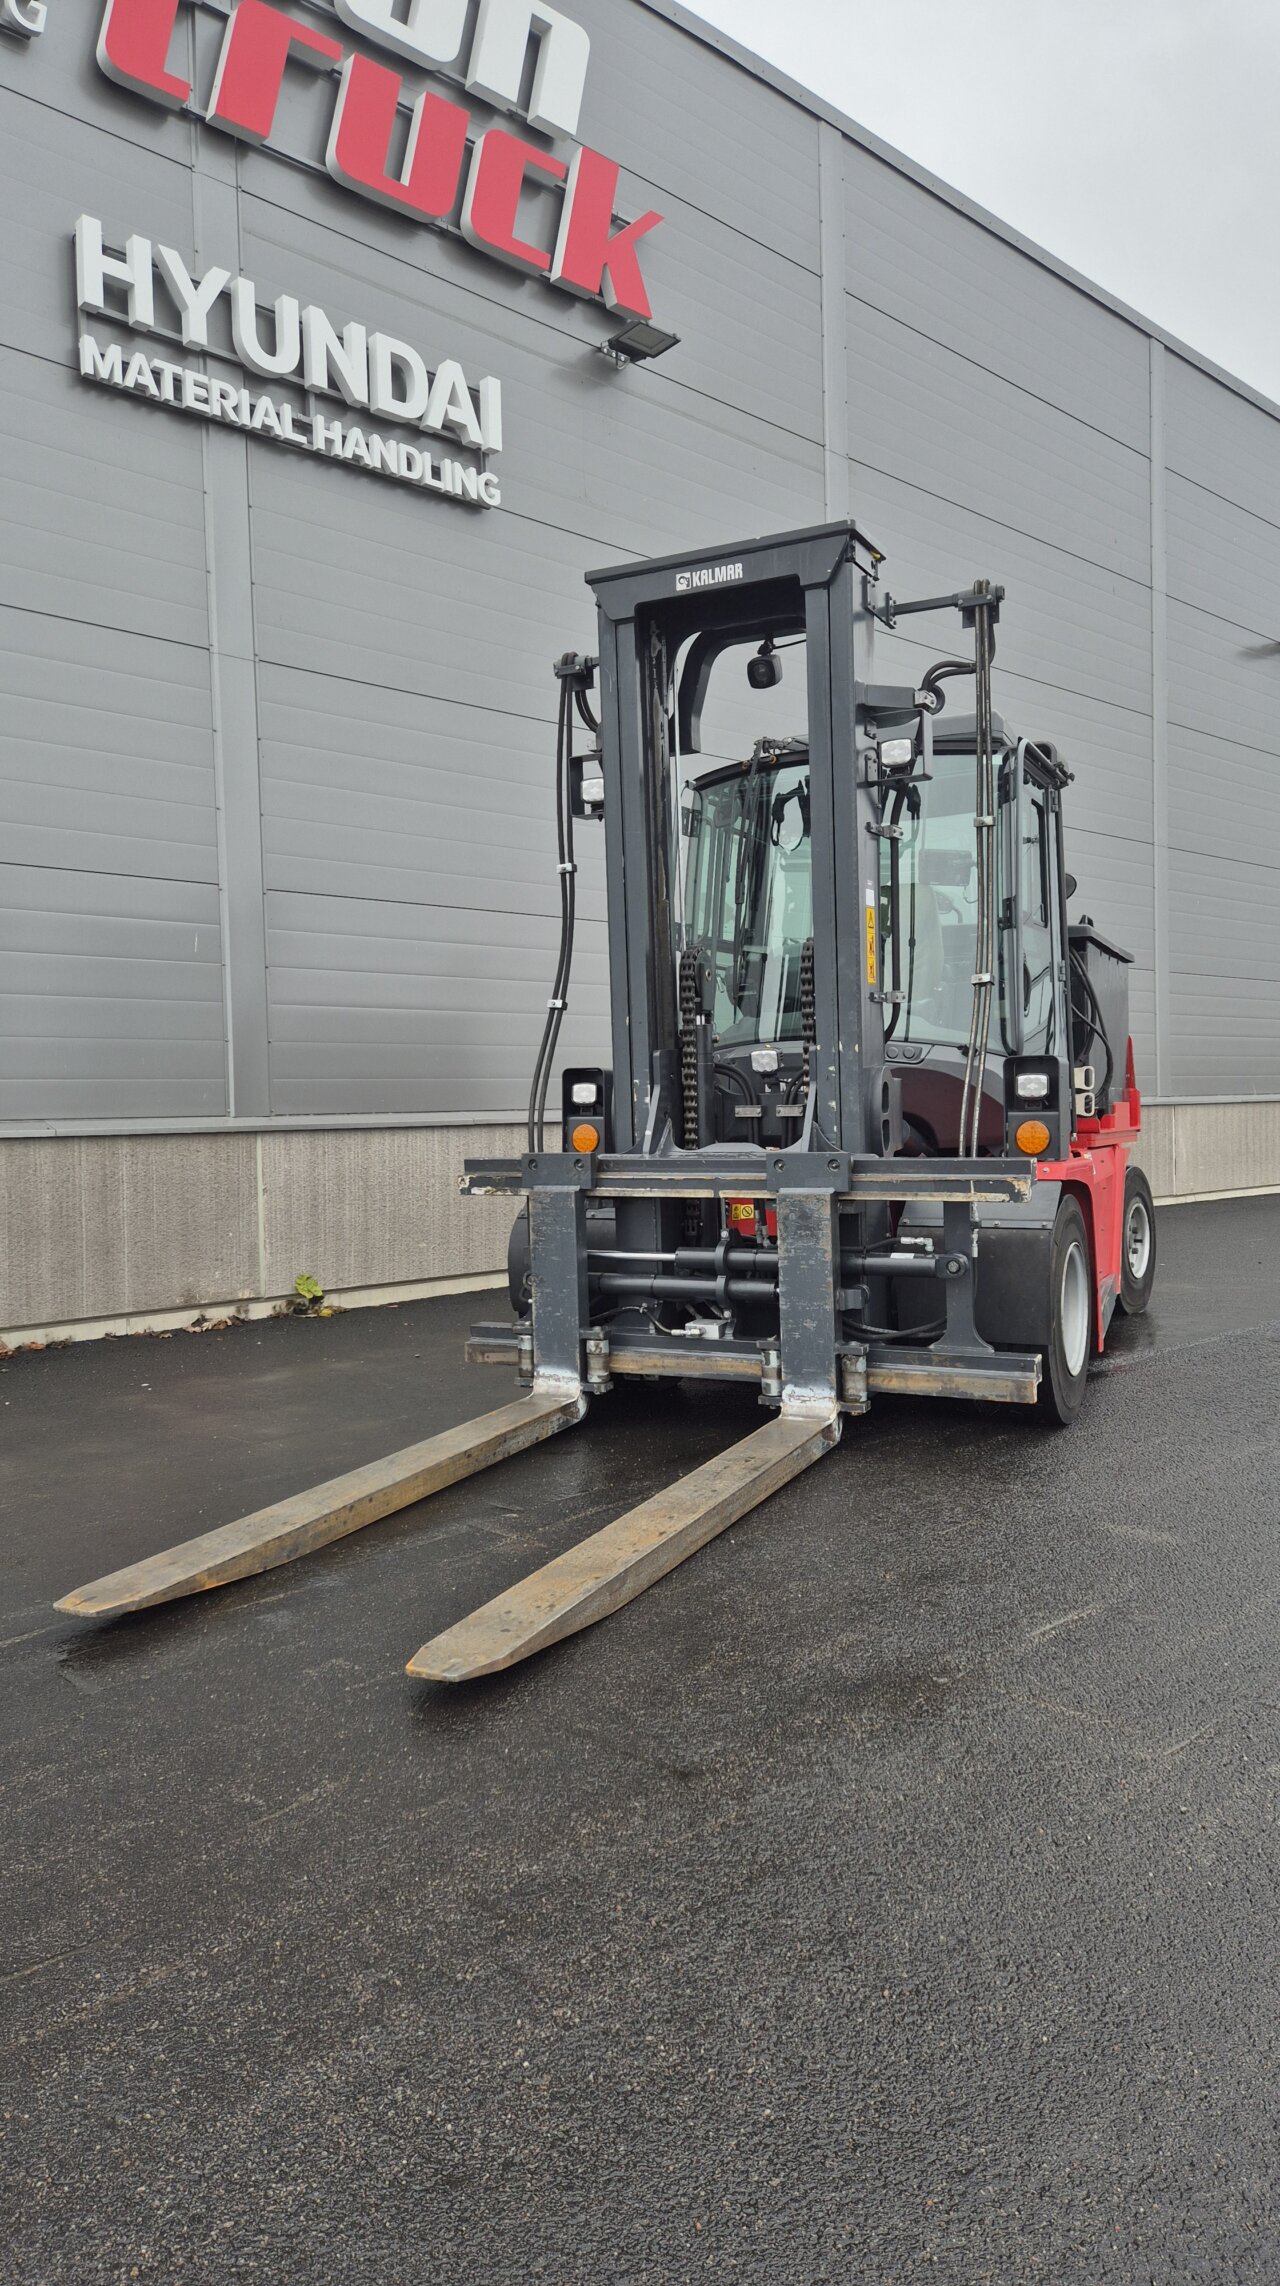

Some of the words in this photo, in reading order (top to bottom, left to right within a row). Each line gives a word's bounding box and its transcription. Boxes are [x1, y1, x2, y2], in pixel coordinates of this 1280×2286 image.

[75, 214, 501, 455] HYUNDAI
[79, 333, 308, 446] MATERIAL
[312, 413, 500, 506] HANDLING
[692, 562, 743, 588] KALMAR
